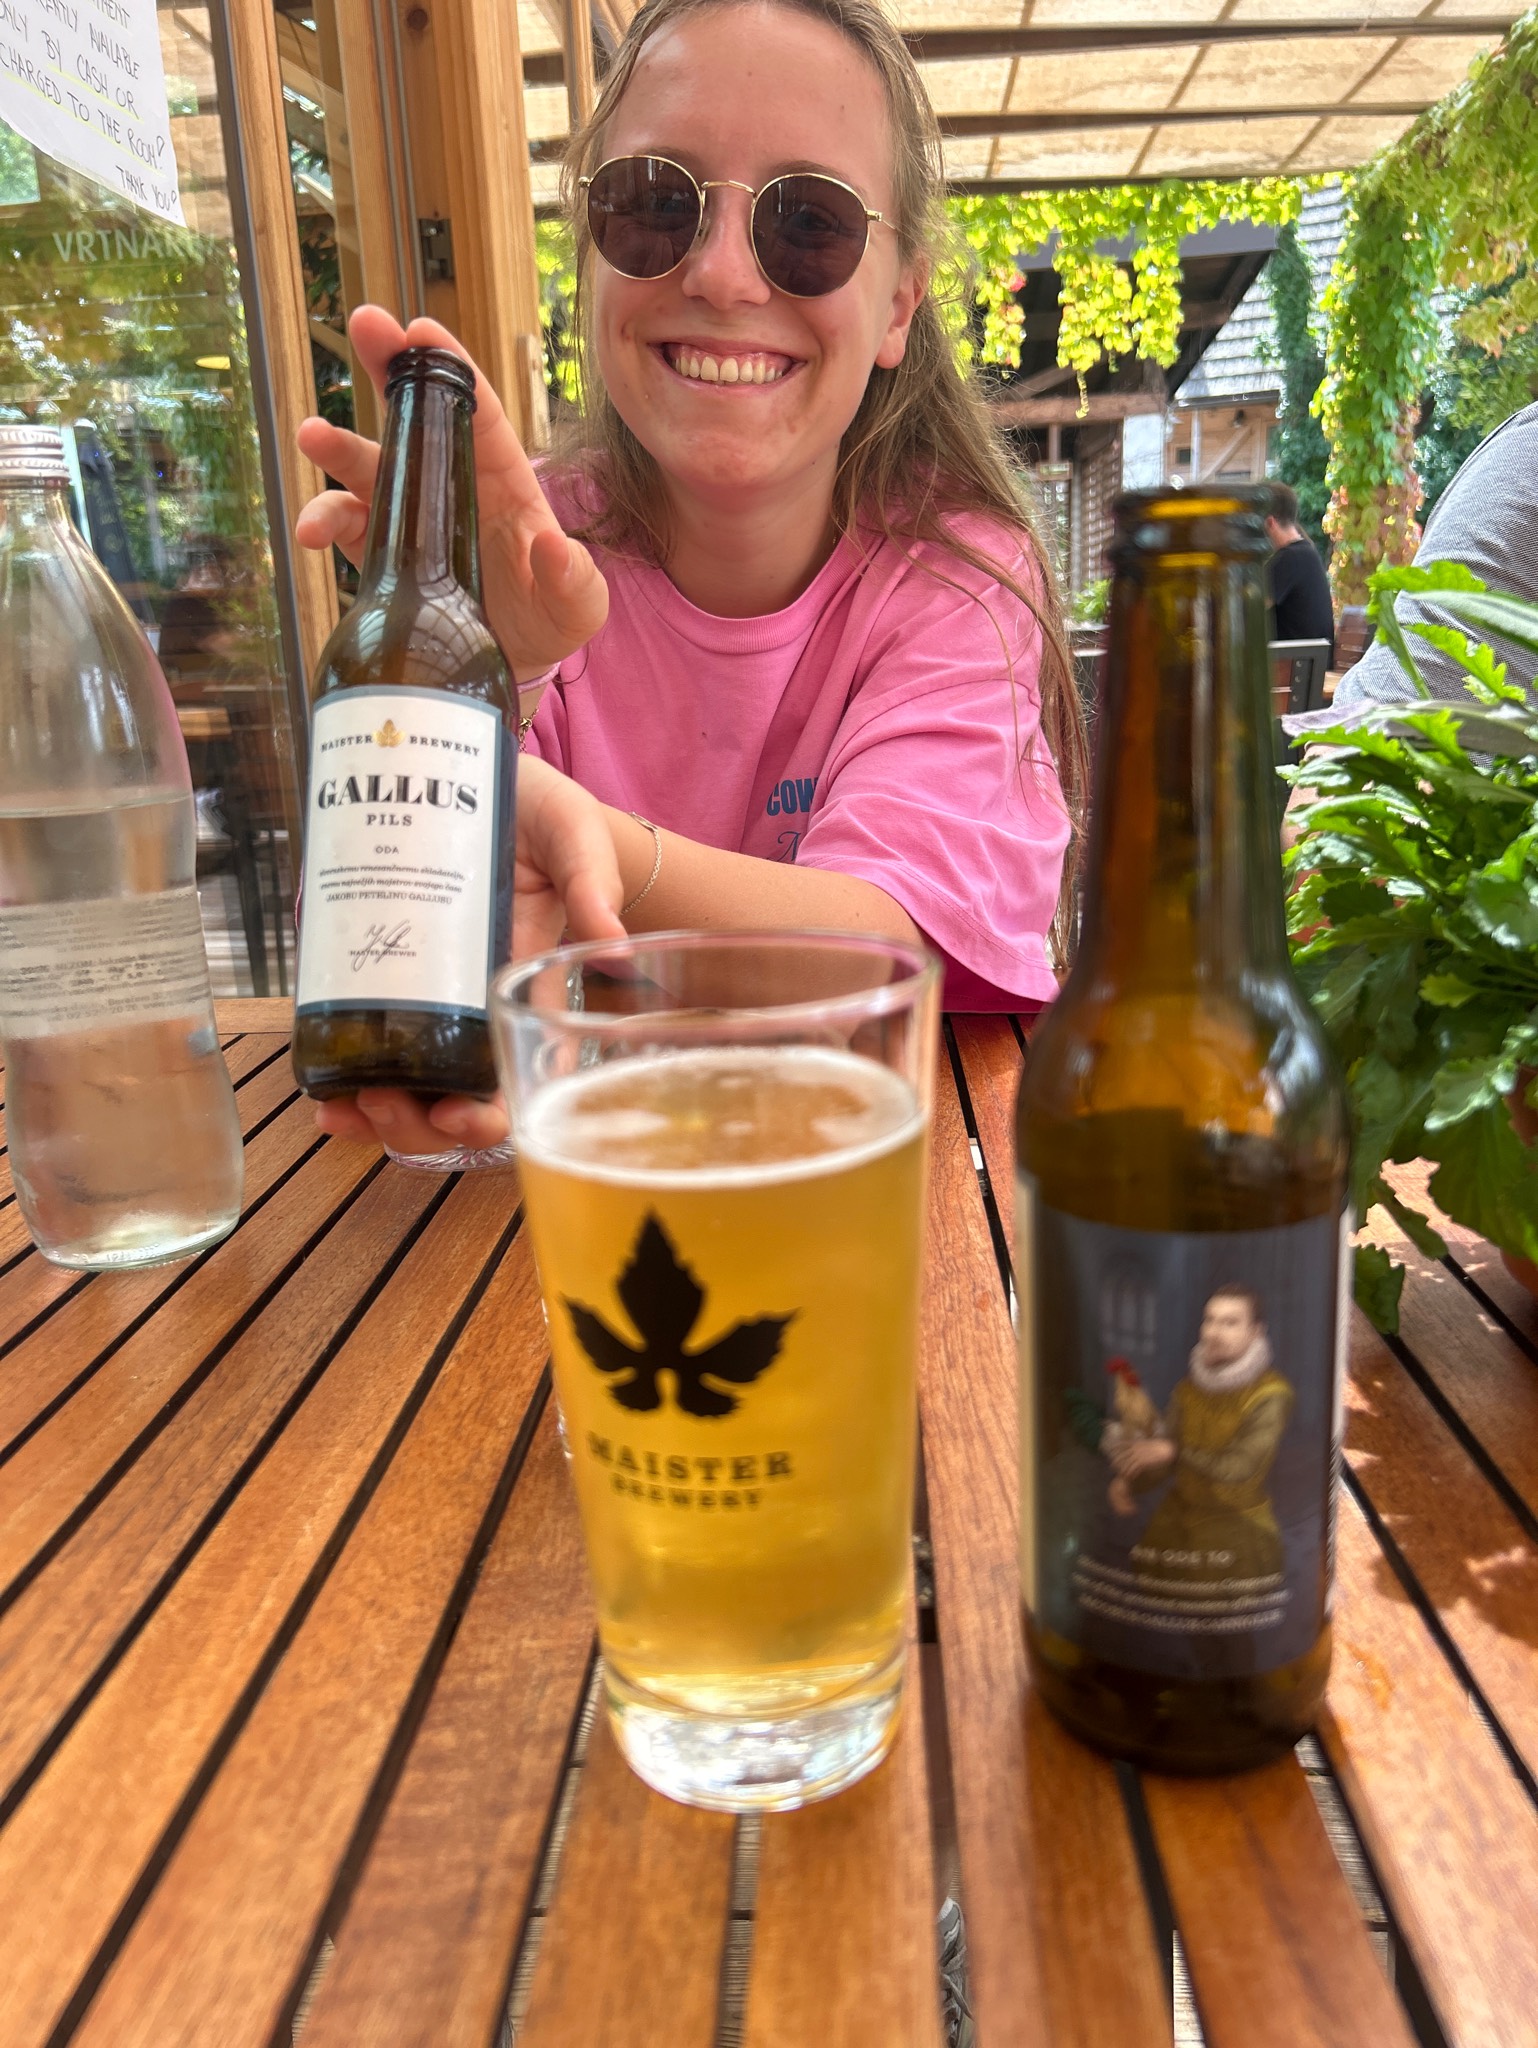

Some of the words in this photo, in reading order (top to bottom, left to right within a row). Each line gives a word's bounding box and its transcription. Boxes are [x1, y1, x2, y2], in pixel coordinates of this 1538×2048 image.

[89, 22, 141, 80] AVAILABLE
[0, 42, 62, 105] CHARGED
[67, 91, 90, 122] TO
[97, 108, 121, 144] THE
[41, 30, 62, 73] BY
[77, 54, 110, 100] CASH
[116, 87, 140, 120] OR
[115, 165, 148, 201] THANK
[320, 735, 374, 754] MAISTER
[409, 735, 481, 757] BREWERY
[317, 774, 479, 816] GALLUS
[366, 814, 414, 828] PILS
[375, 845, 401, 855] ODA
[587, 1430, 794, 1482] MAISTER
